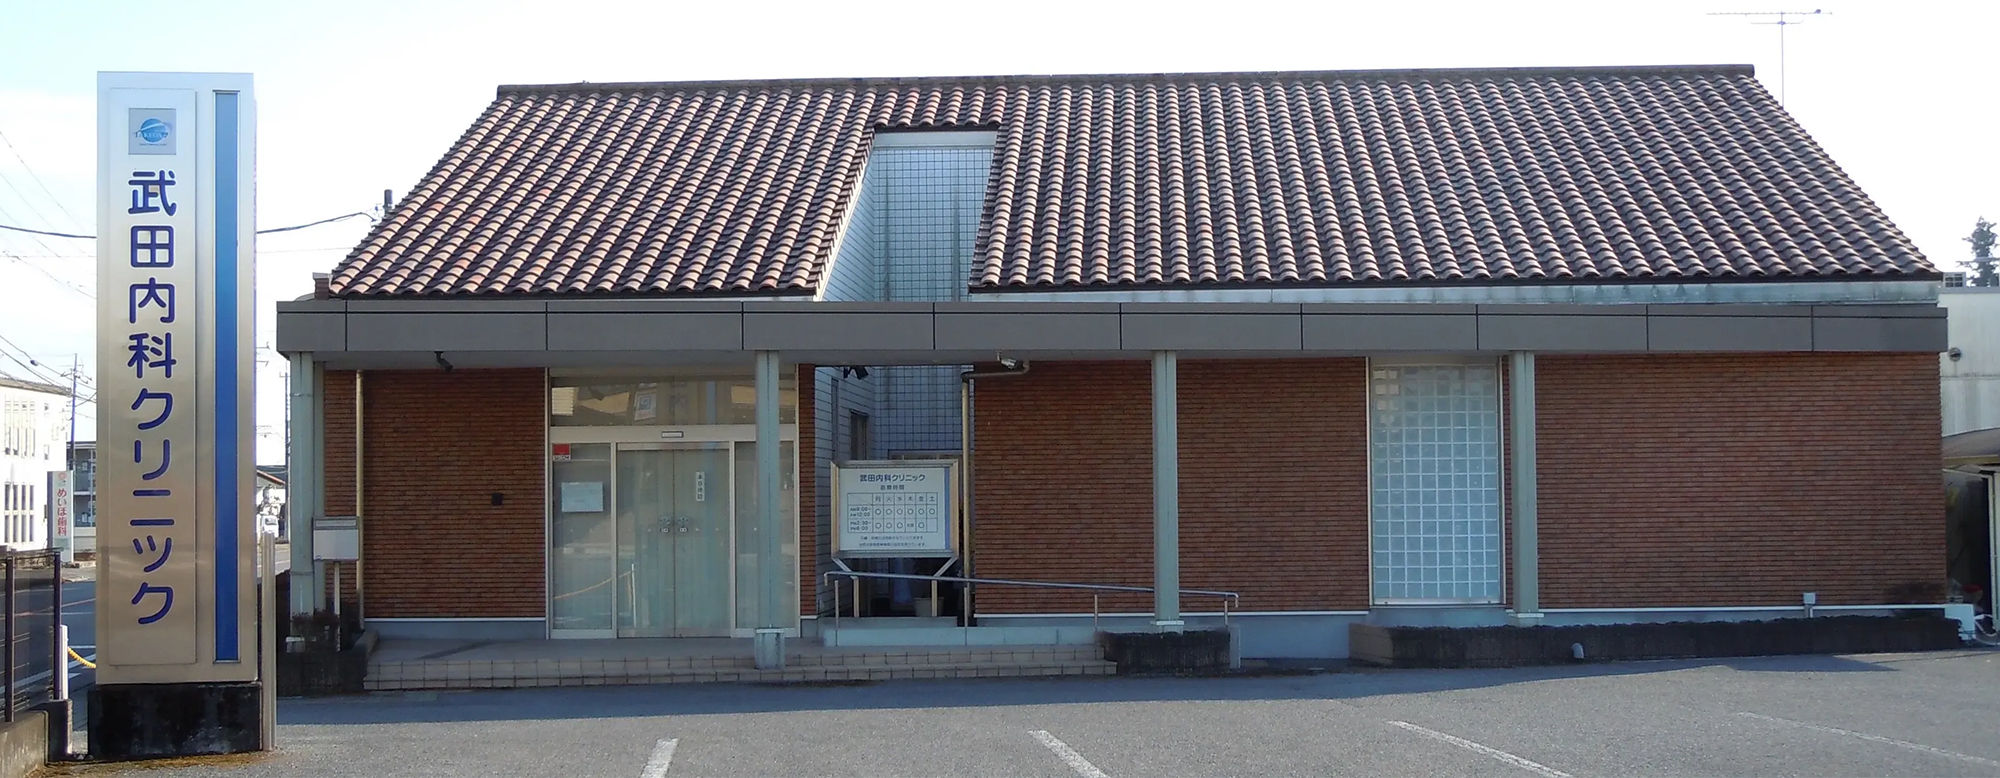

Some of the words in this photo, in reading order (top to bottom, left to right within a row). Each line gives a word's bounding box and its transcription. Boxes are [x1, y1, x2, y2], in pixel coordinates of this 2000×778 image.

[127, 169, 178, 626] 武田内科クリニック
[859, 474, 926, 482] 武田内科クリニック
